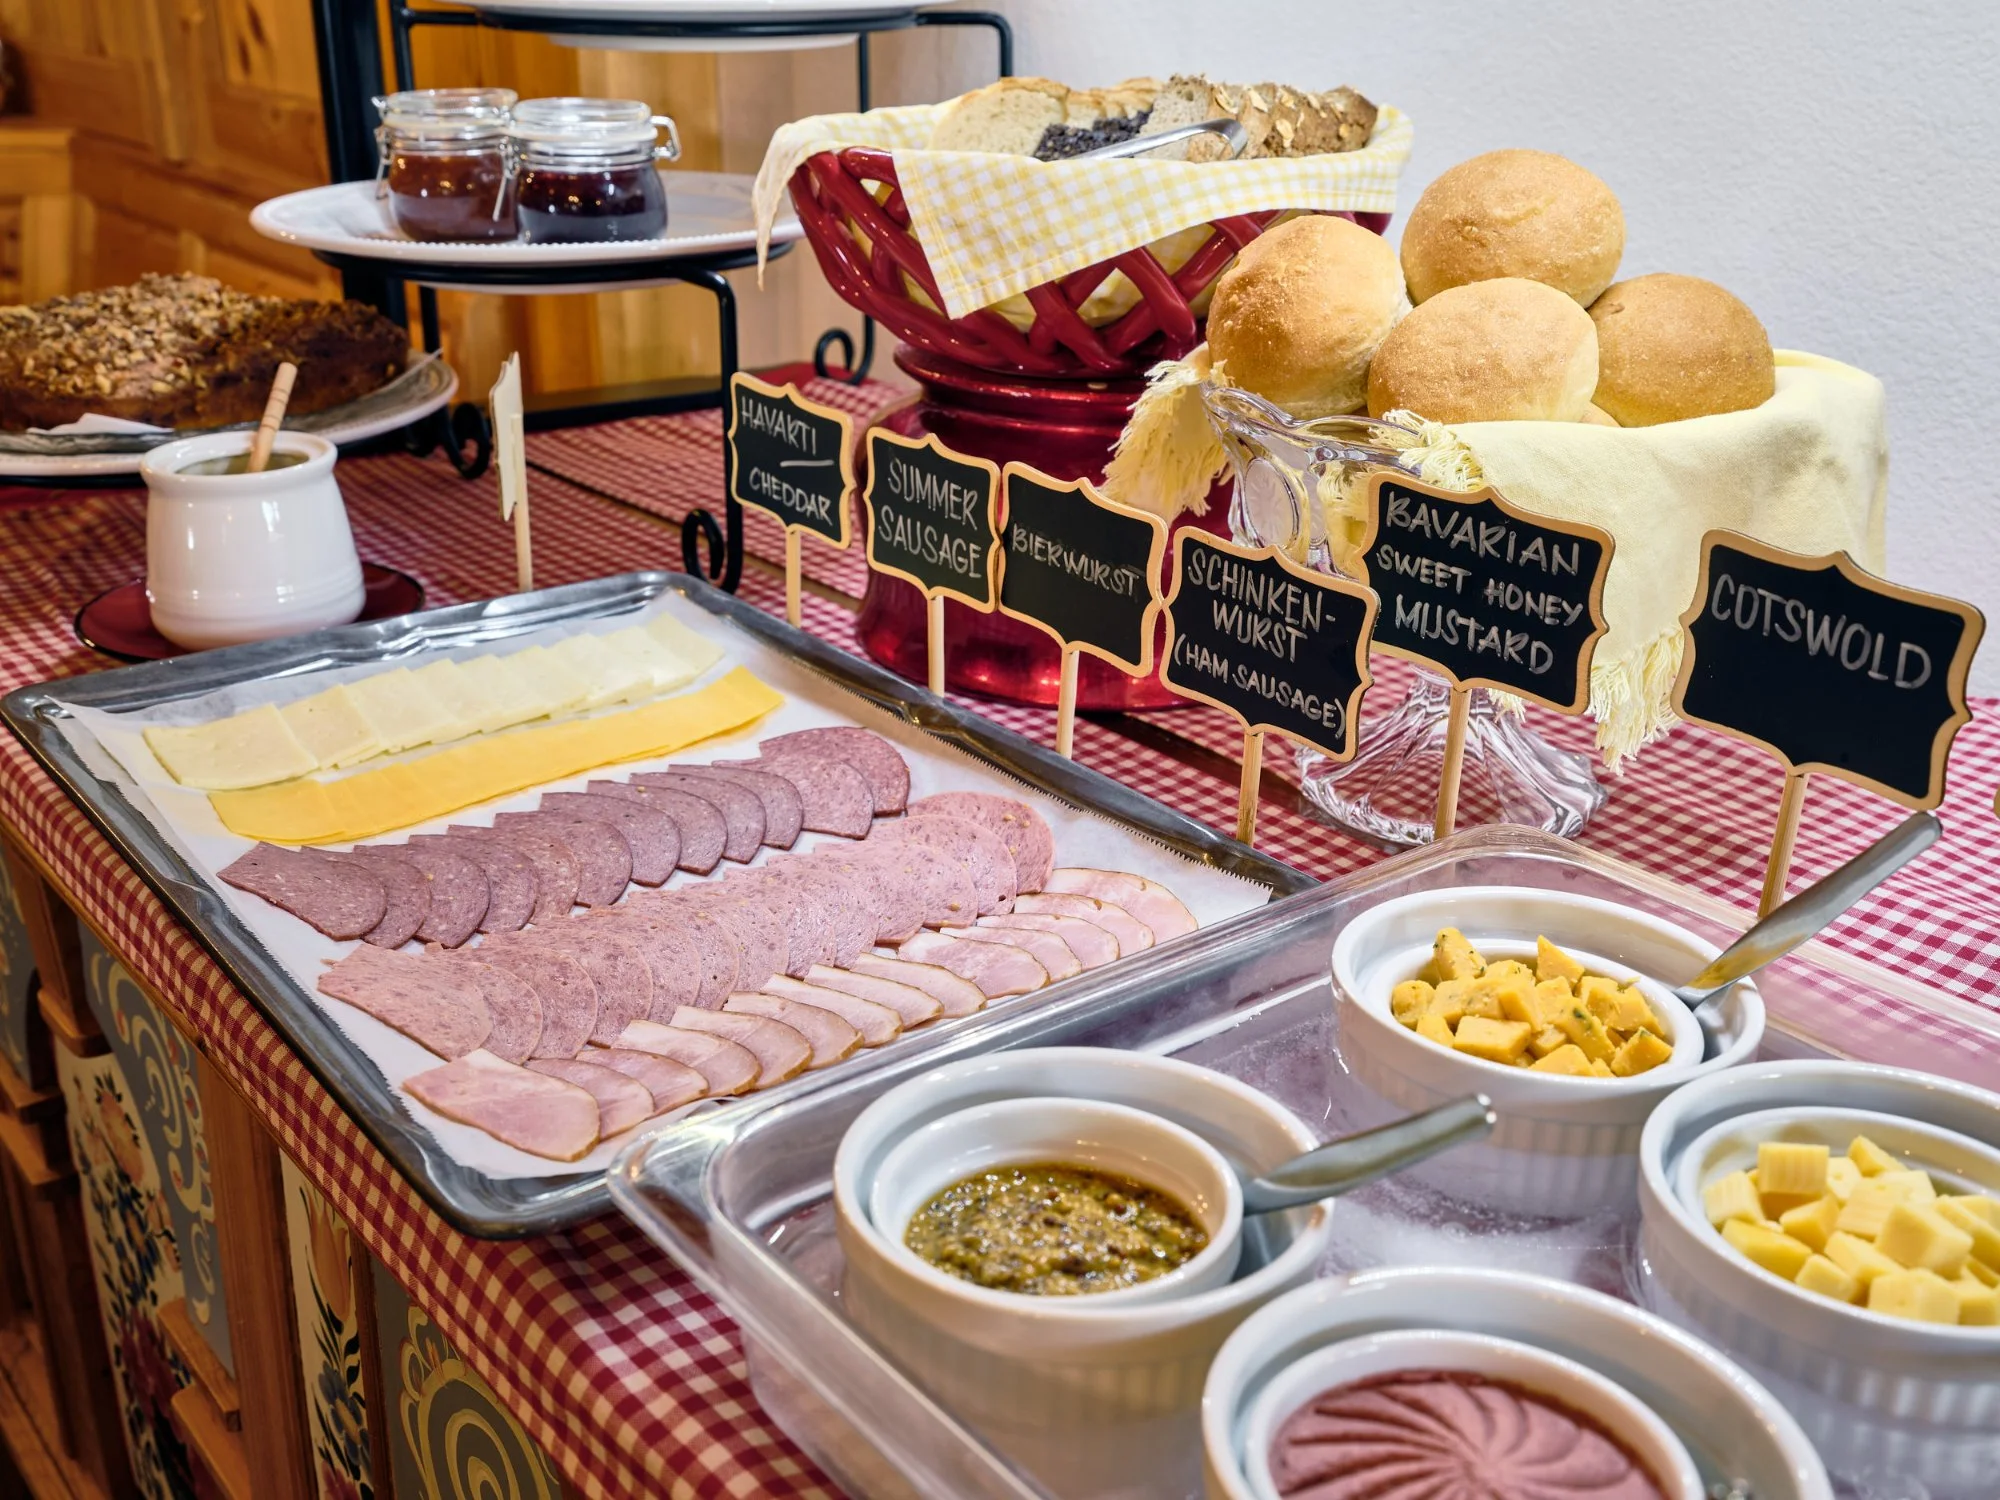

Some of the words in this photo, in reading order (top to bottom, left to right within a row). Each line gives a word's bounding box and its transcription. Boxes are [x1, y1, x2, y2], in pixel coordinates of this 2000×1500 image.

[741, 395, 817, 456] HAVARTI
[749, 466, 833, 527] CHEDDAR
[887, 456, 978, 531] SUMMER
[878, 505, 982, 578] SAUSAGE
[1011, 522, 1140, 596] BIERWURST
[1386, 491, 1580, 576] BAVARIAN
[1187, 548, 1336, 632] SCHINKEN-
[1376, 543, 1472, 595] SWEET
[1484, 577, 1584, 627] HONEY
[1213, 599, 1308, 663] WURST
[1395, 593, 1554, 675] MUSTARD
[1711, 573, 1932, 689] COTSWOLD
[1174, 633, 1228, 683] (HAM
[1232, 664, 1346, 740] SAUSAGE)
